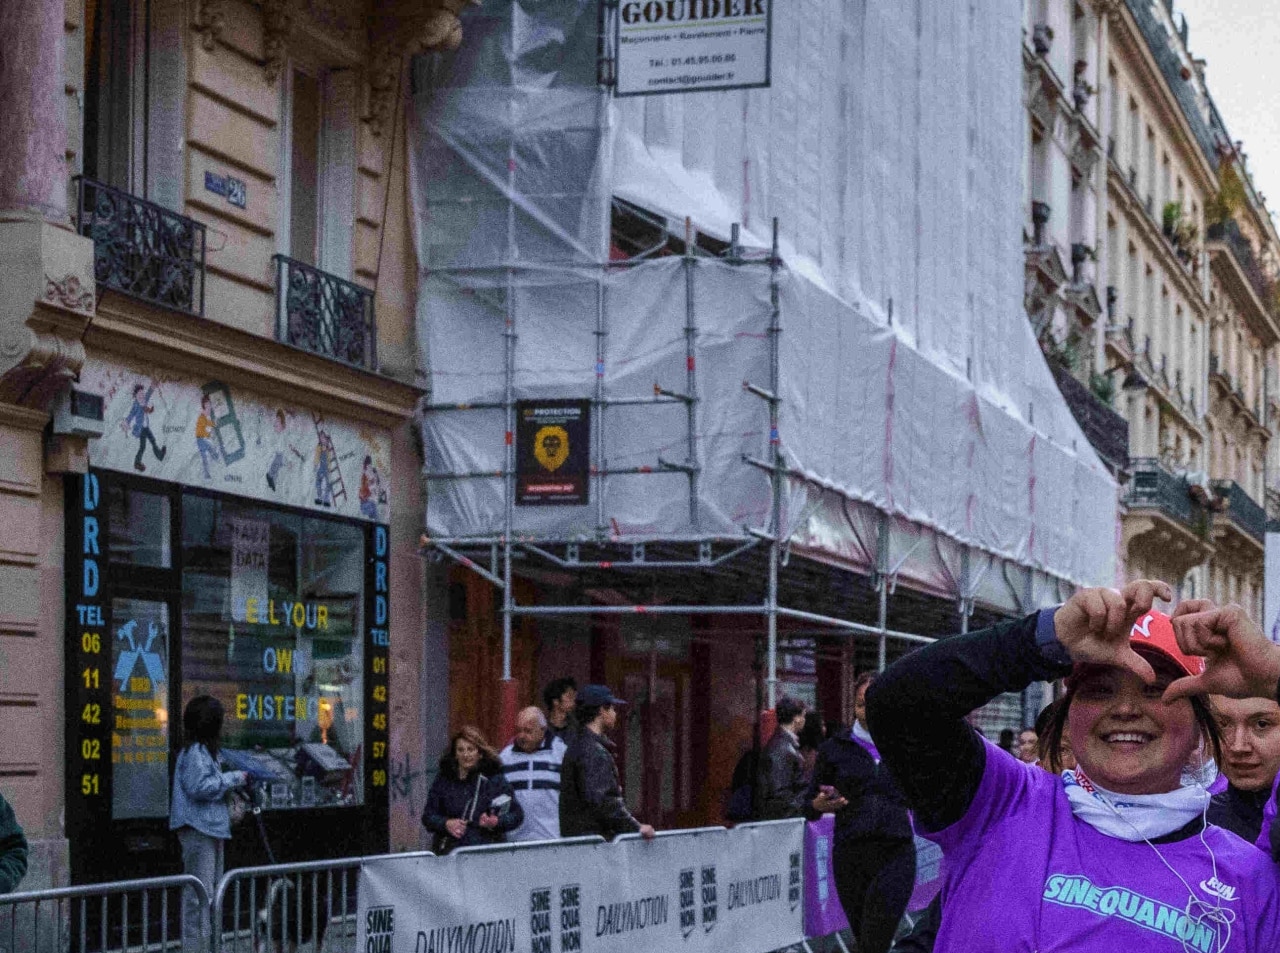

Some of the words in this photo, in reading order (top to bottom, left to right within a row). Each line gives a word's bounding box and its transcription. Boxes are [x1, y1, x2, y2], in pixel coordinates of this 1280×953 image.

[622, 0, 765, 23] GOUIDER
[76, 604, 105, 625] TEL
[283, 602, 328, 629] YOUR
[82, 633, 100, 653] 06
[370, 629, 390, 647] TEL
[373, 657, 386, 673] 01
[82, 668, 100, 688] 11
[82, 704, 100, 724] 42
[82, 739, 100, 759] 02
[373, 742, 386, 758] 57
[82, 775, 100, 794] 51
[561, 886, 580, 907] SINE
[728, 874, 781, 910] DAILYMOTION
[1207, 877, 1236, 898] RUN
[531, 891, 550, 912] SINE
[367, 908, 394, 934] SINE
[531, 913, 550, 935] QUA
[561, 909, 580, 930] QUA
[596, 895, 669, 937] DAILYMOTION
[561, 931, 581, 952] NON
